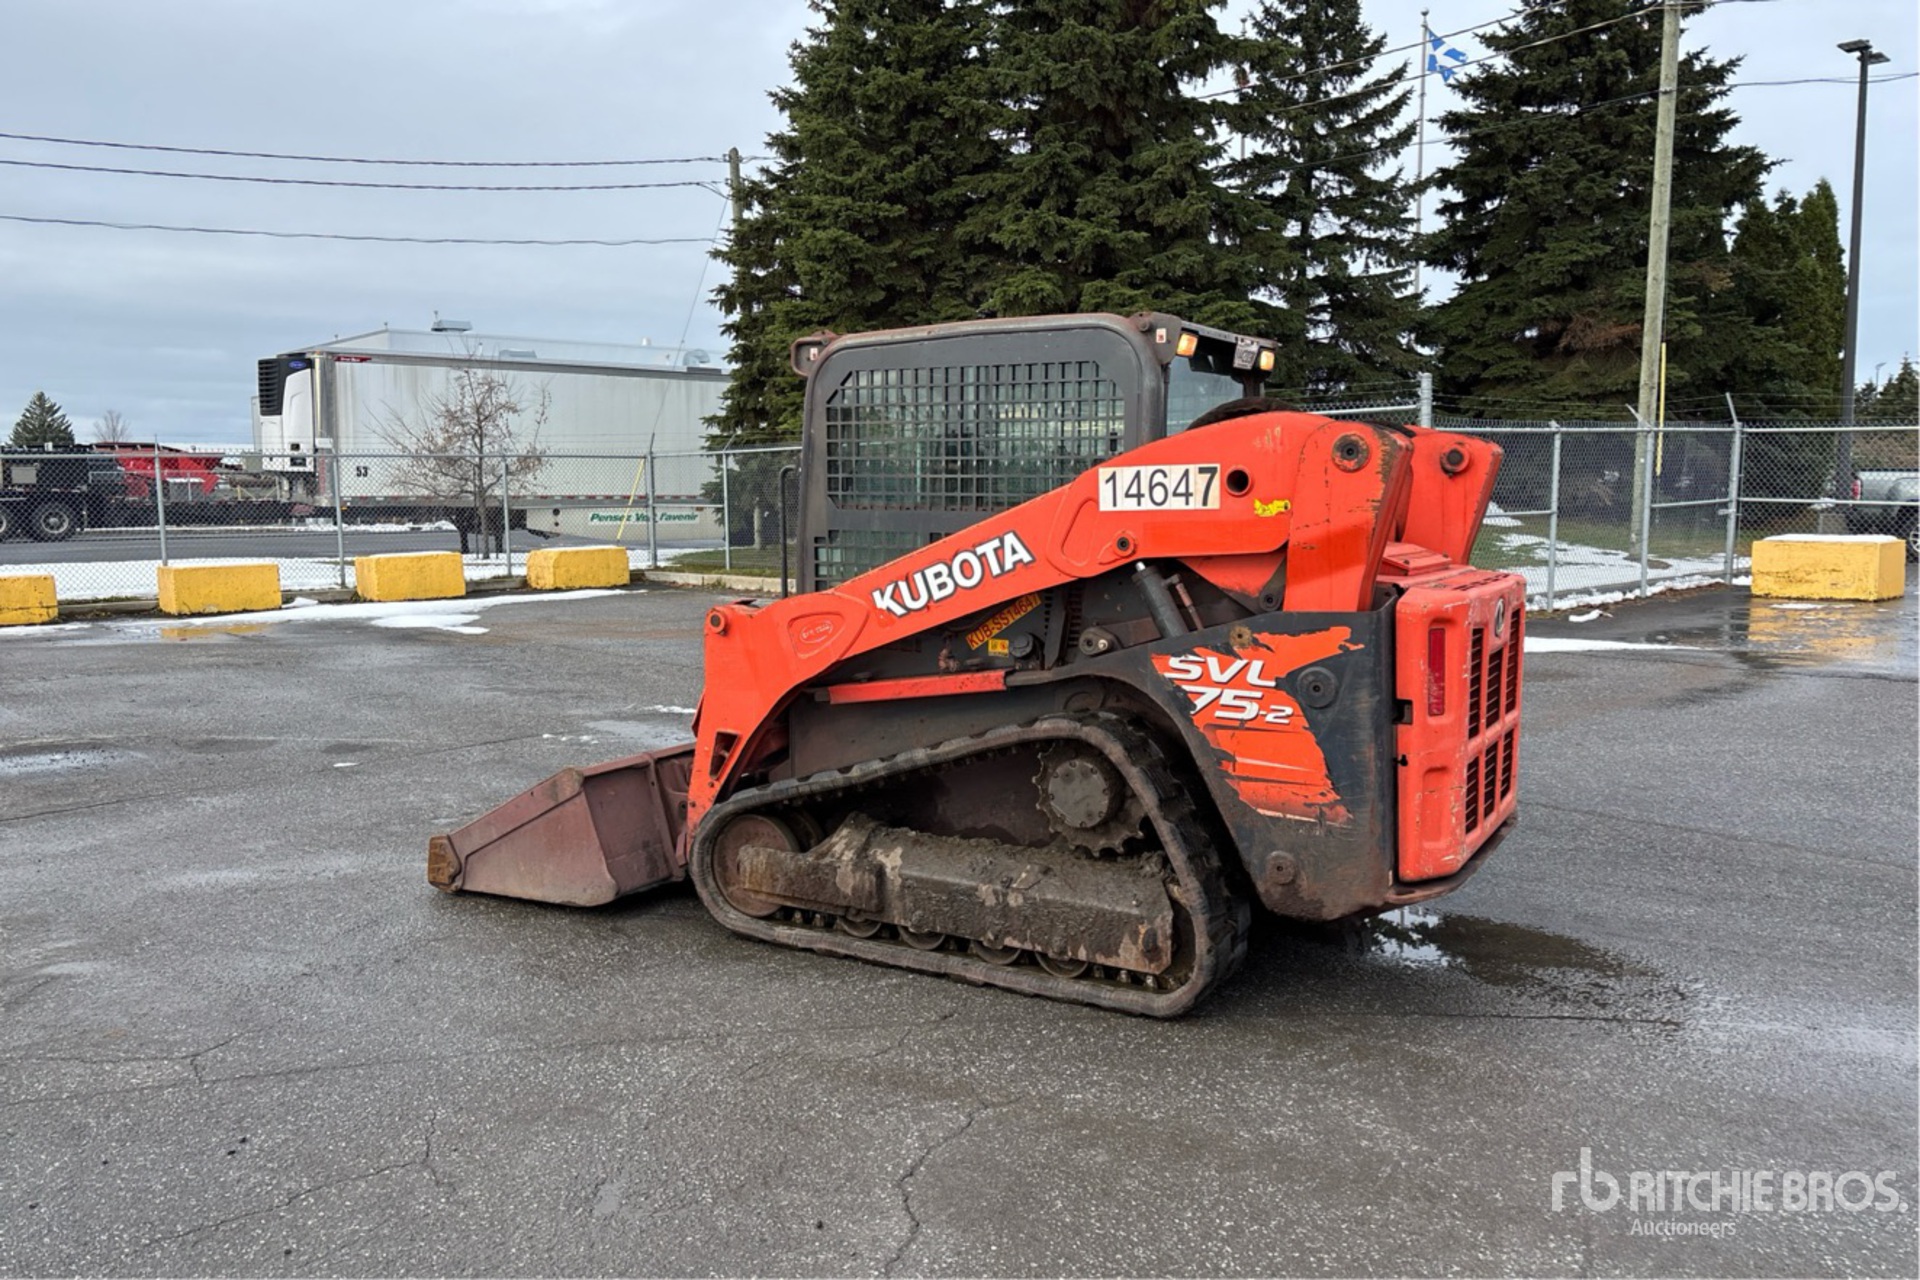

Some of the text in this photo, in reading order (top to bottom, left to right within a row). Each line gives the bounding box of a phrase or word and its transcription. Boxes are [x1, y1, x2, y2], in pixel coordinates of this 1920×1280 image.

[356, 466, 368, 477] 53
[1105, 467, 1218, 507] 14647
[871, 530, 1036, 617] KUBOTA
[966, 593, 1040, 648] KUB-SS14647
[1164, 654, 1277, 688] SVL
[1180, 685, 1294, 725] 75-2
